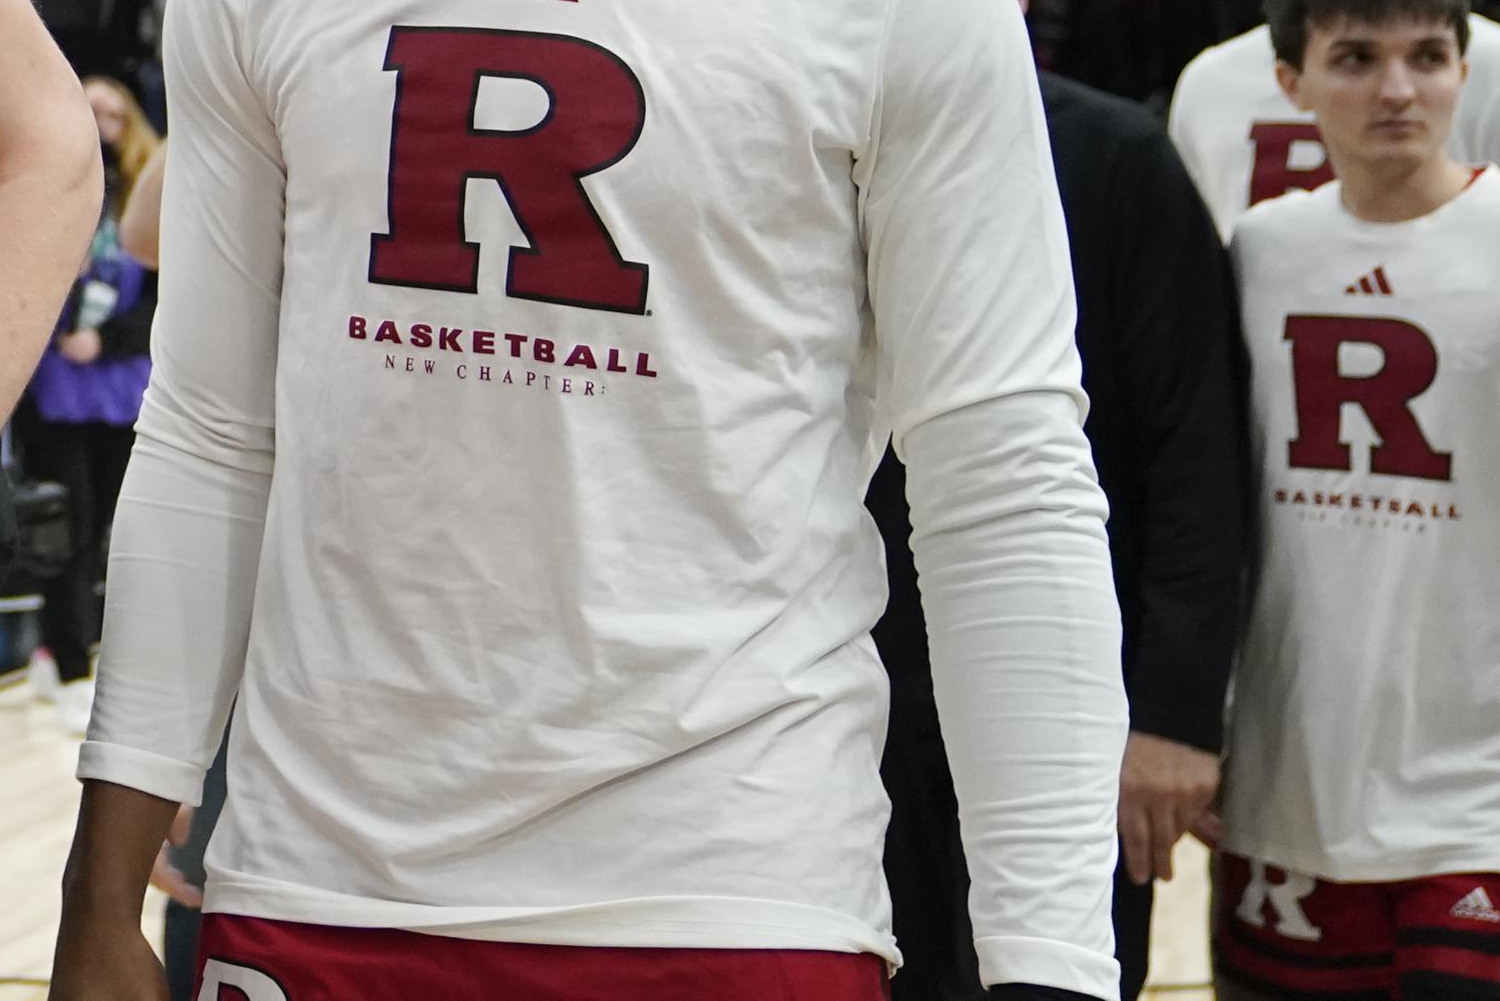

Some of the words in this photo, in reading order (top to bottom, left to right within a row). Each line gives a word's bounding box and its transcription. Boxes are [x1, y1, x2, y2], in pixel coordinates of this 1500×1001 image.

[367, 24, 650, 316] R
[348, 315, 659, 378] BASKETBALL
[384, 353, 436, 375] NEW
[1281, 313, 1453, 483] R
[1274, 487, 1461, 521] BASKETBALL
